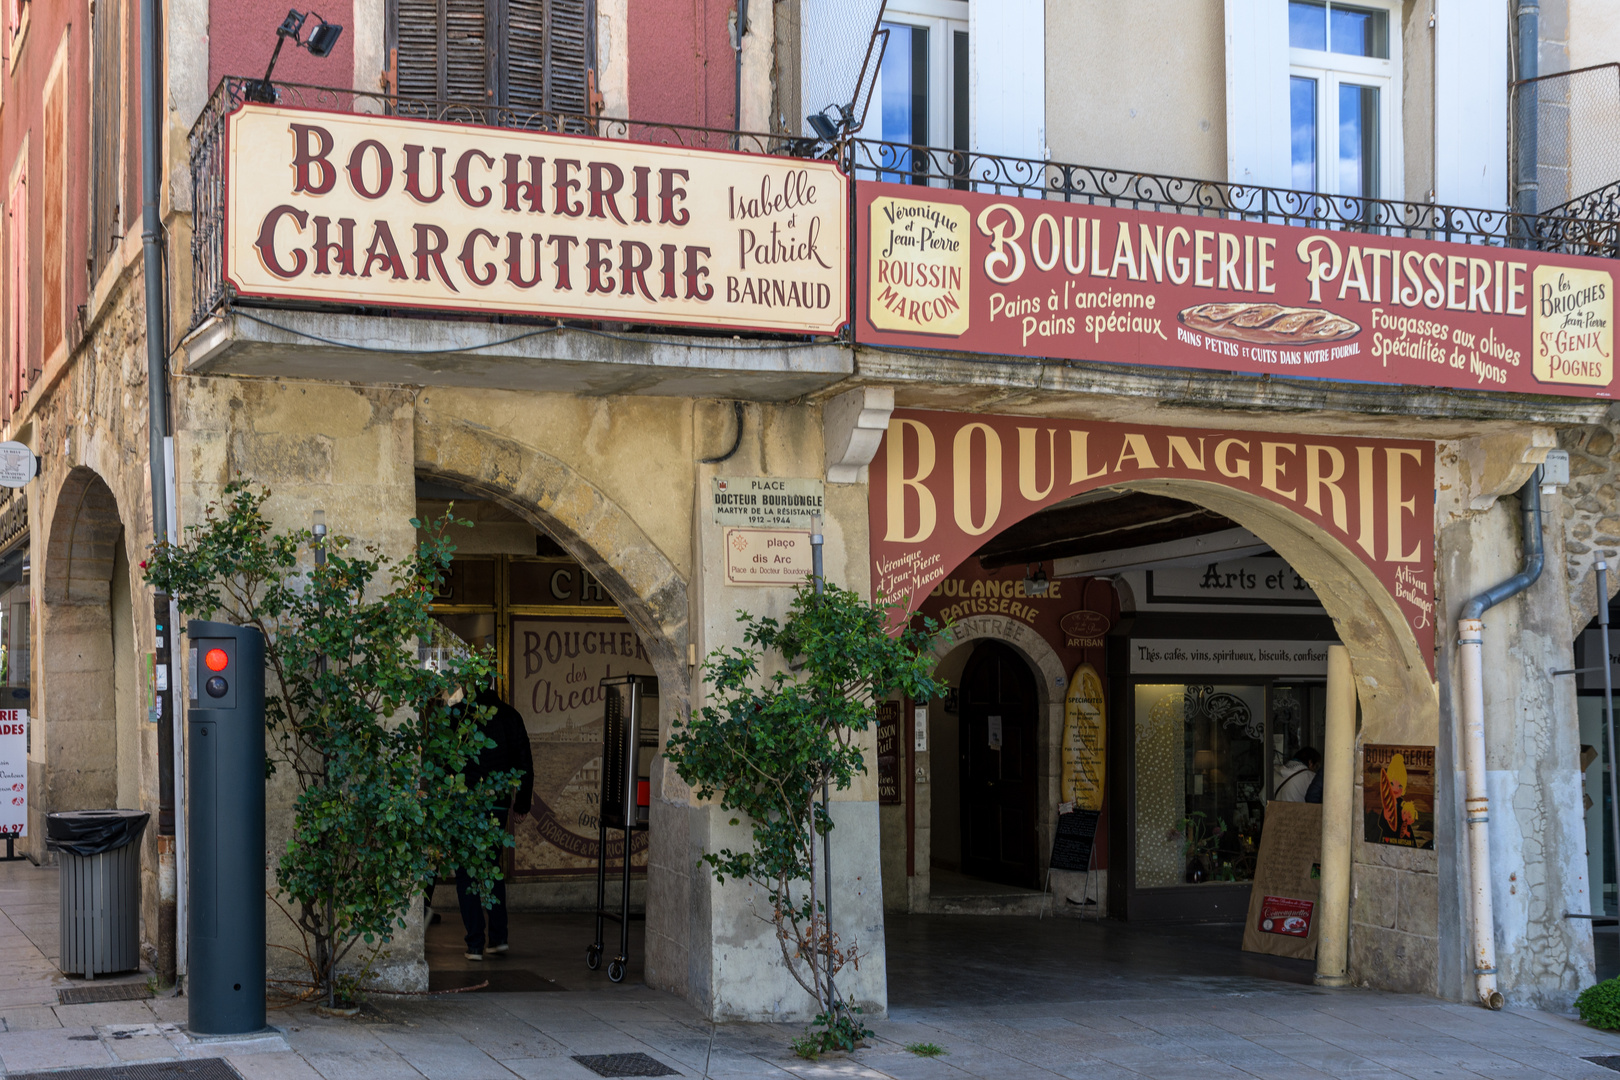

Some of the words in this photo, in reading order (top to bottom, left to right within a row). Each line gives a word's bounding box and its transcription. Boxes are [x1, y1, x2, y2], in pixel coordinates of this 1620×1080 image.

[289, 122, 691, 227] BOUCHERIE
[728, 170, 817, 221] Isabelle
[787, 211, 798, 229] et
[883, 201, 957, 233] Véronique
[905, 220, 914, 232] et
[254, 203, 715, 303] CHARCUTERIE
[738, 215, 832, 270] Patrick
[882, 226, 960, 258] Jean-Pierre
[976, 202, 1277, 294] BOULANGERIE
[1297, 235, 1528, 316] PATISSERIE
[878, 259, 962, 291] ROUSSIN
[1558, 273, 1570, 292] les
[726, 275, 831, 310] BARNAUD
[877, 285, 960, 326] MARCON
[989, 292, 1041, 322] Pains
[1048, 288, 1059, 312] à
[1064, 280, 1156, 311] l'ancienne
[1539, 283, 1605, 318] BRIOCHES
[1022, 315, 1075, 347] Pains
[1085, 311, 1168, 344] spéciaux
[1560, 311, 1607, 330] Jean-Pierre
[1177, 327, 1202, 349] PAINS
[1205, 334, 1239, 357] PETRIS
[1242, 348, 1250, 357] ET
[1251, 347, 1277, 365] CUITS
[1280, 348, 1301, 365] DANS
[1303, 345, 1329, 364] NOTRE
[1330, 342, 1361, 361] FOURNIL
[1371, 308, 1449, 341] Fougasses
[1452, 329, 1475, 350] aux
[1480, 327, 1521, 367] olives
[1555, 330, 1609, 358] GENIX
[1371, 332, 1446, 367] Spécialités
[1449, 345, 1466, 369] de
[1470, 350, 1507, 385] Nyons
[1549, 355, 1602, 379] POGNES
[715, 493, 756, 505] DOCTEUR
[762, 494, 823, 507] BOURDONGLE
[752, 481, 785, 490] PLACE
[882, 417, 1422, 564] BOULANGERIE
[777, 507, 820, 515] RÉSISTANCE
[752, 554, 768, 563] dis
[773, 554, 791, 564] Arc
[767, 538, 795, 549] plaço
[783, 567, 812, 575] Bourdongle
[876, 550, 922, 576] Véronique
[876, 577, 886, 591] et
[886, 553, 941, 594] Jean-Pierre
[1199, 562, 1256, 589] Arts
[1265, 568, 1284, 590] et
[549, 568, 618, 600] CH
[1395, 564, 1428, 595] Artisan
[940, 597, 1039, 623] PATISSERIE
[1395, 581, 1433, 629] Boulanger
[952, 618, 1025, 642] ENTRÉE
[1067, 638, 1103, 647] ARTISAN
[1190, 650, 1211, 661] vins,
[1212, 650, 1256, 663] spiritueux,
[1259, 649, 1291, 662] biscuits,
[566, 663, 587, 684] des
[1366, 748, 1432, 766] BOULAGERIE
[12, 824, 24, 833] 97
[540, 819, 581, 851] ISABELLE
[580, 844, 587, 855] &
